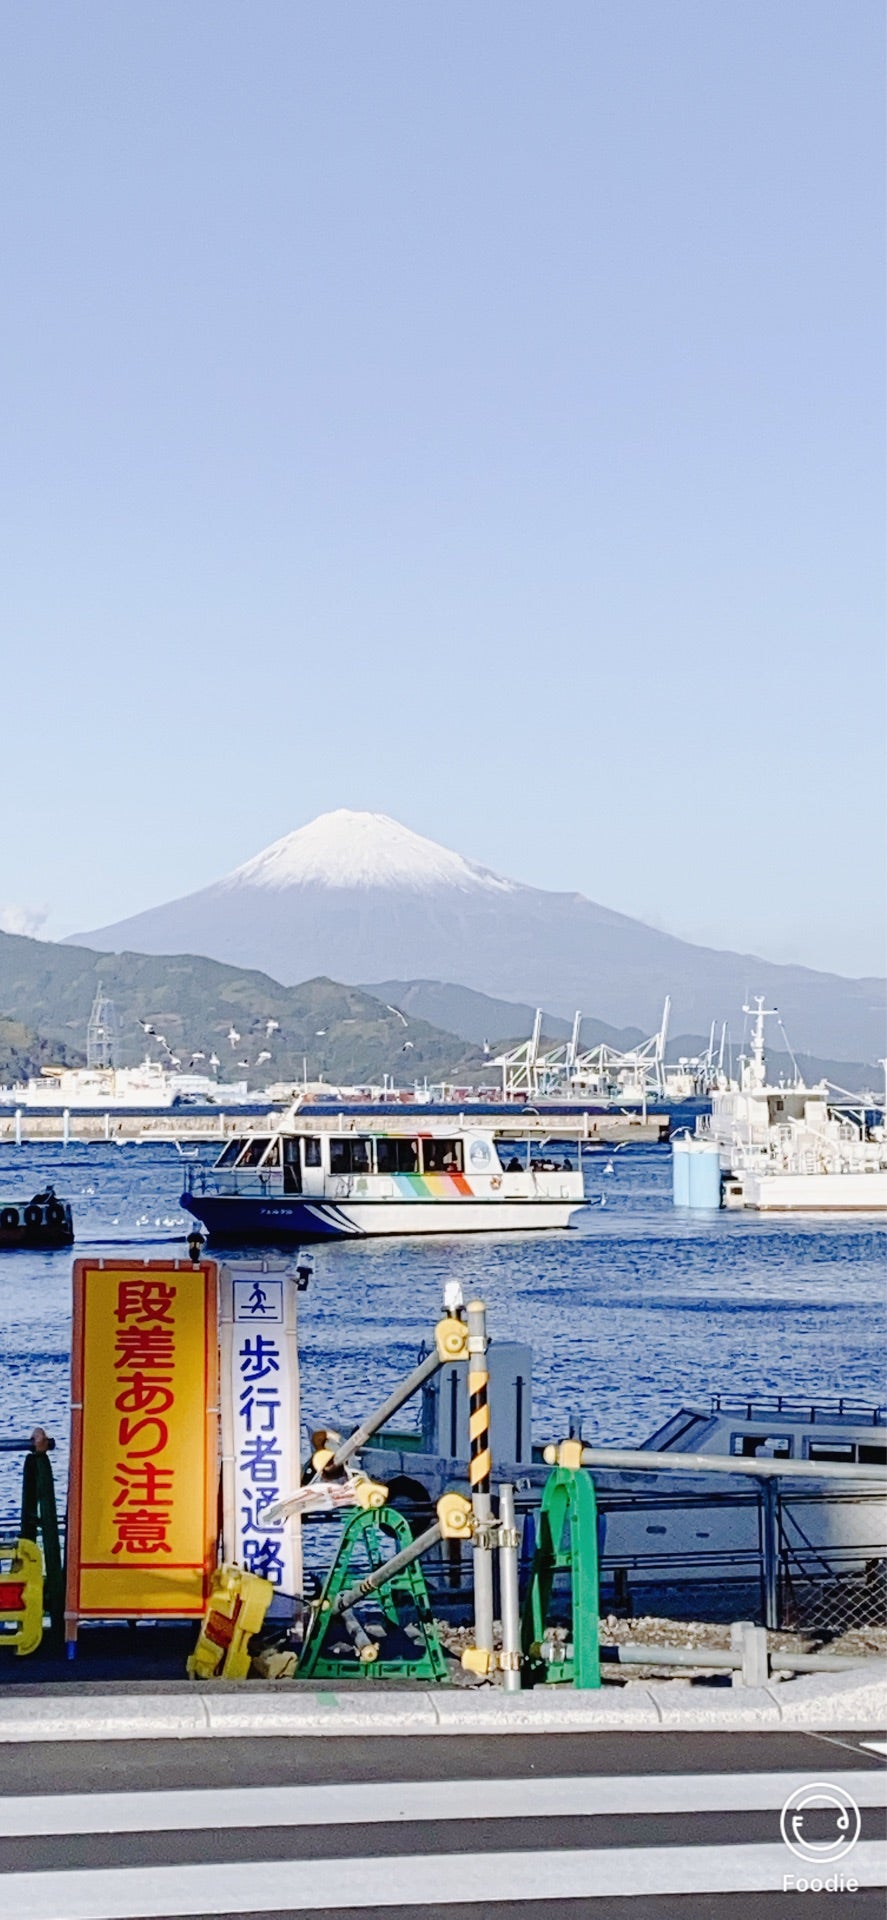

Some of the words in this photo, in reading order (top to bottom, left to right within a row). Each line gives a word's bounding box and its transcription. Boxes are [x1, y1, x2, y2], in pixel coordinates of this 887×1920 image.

[111, 1280, 177, 1555] 段差あり注意
[239, 1334, 285, 1587] 歩行者通路
